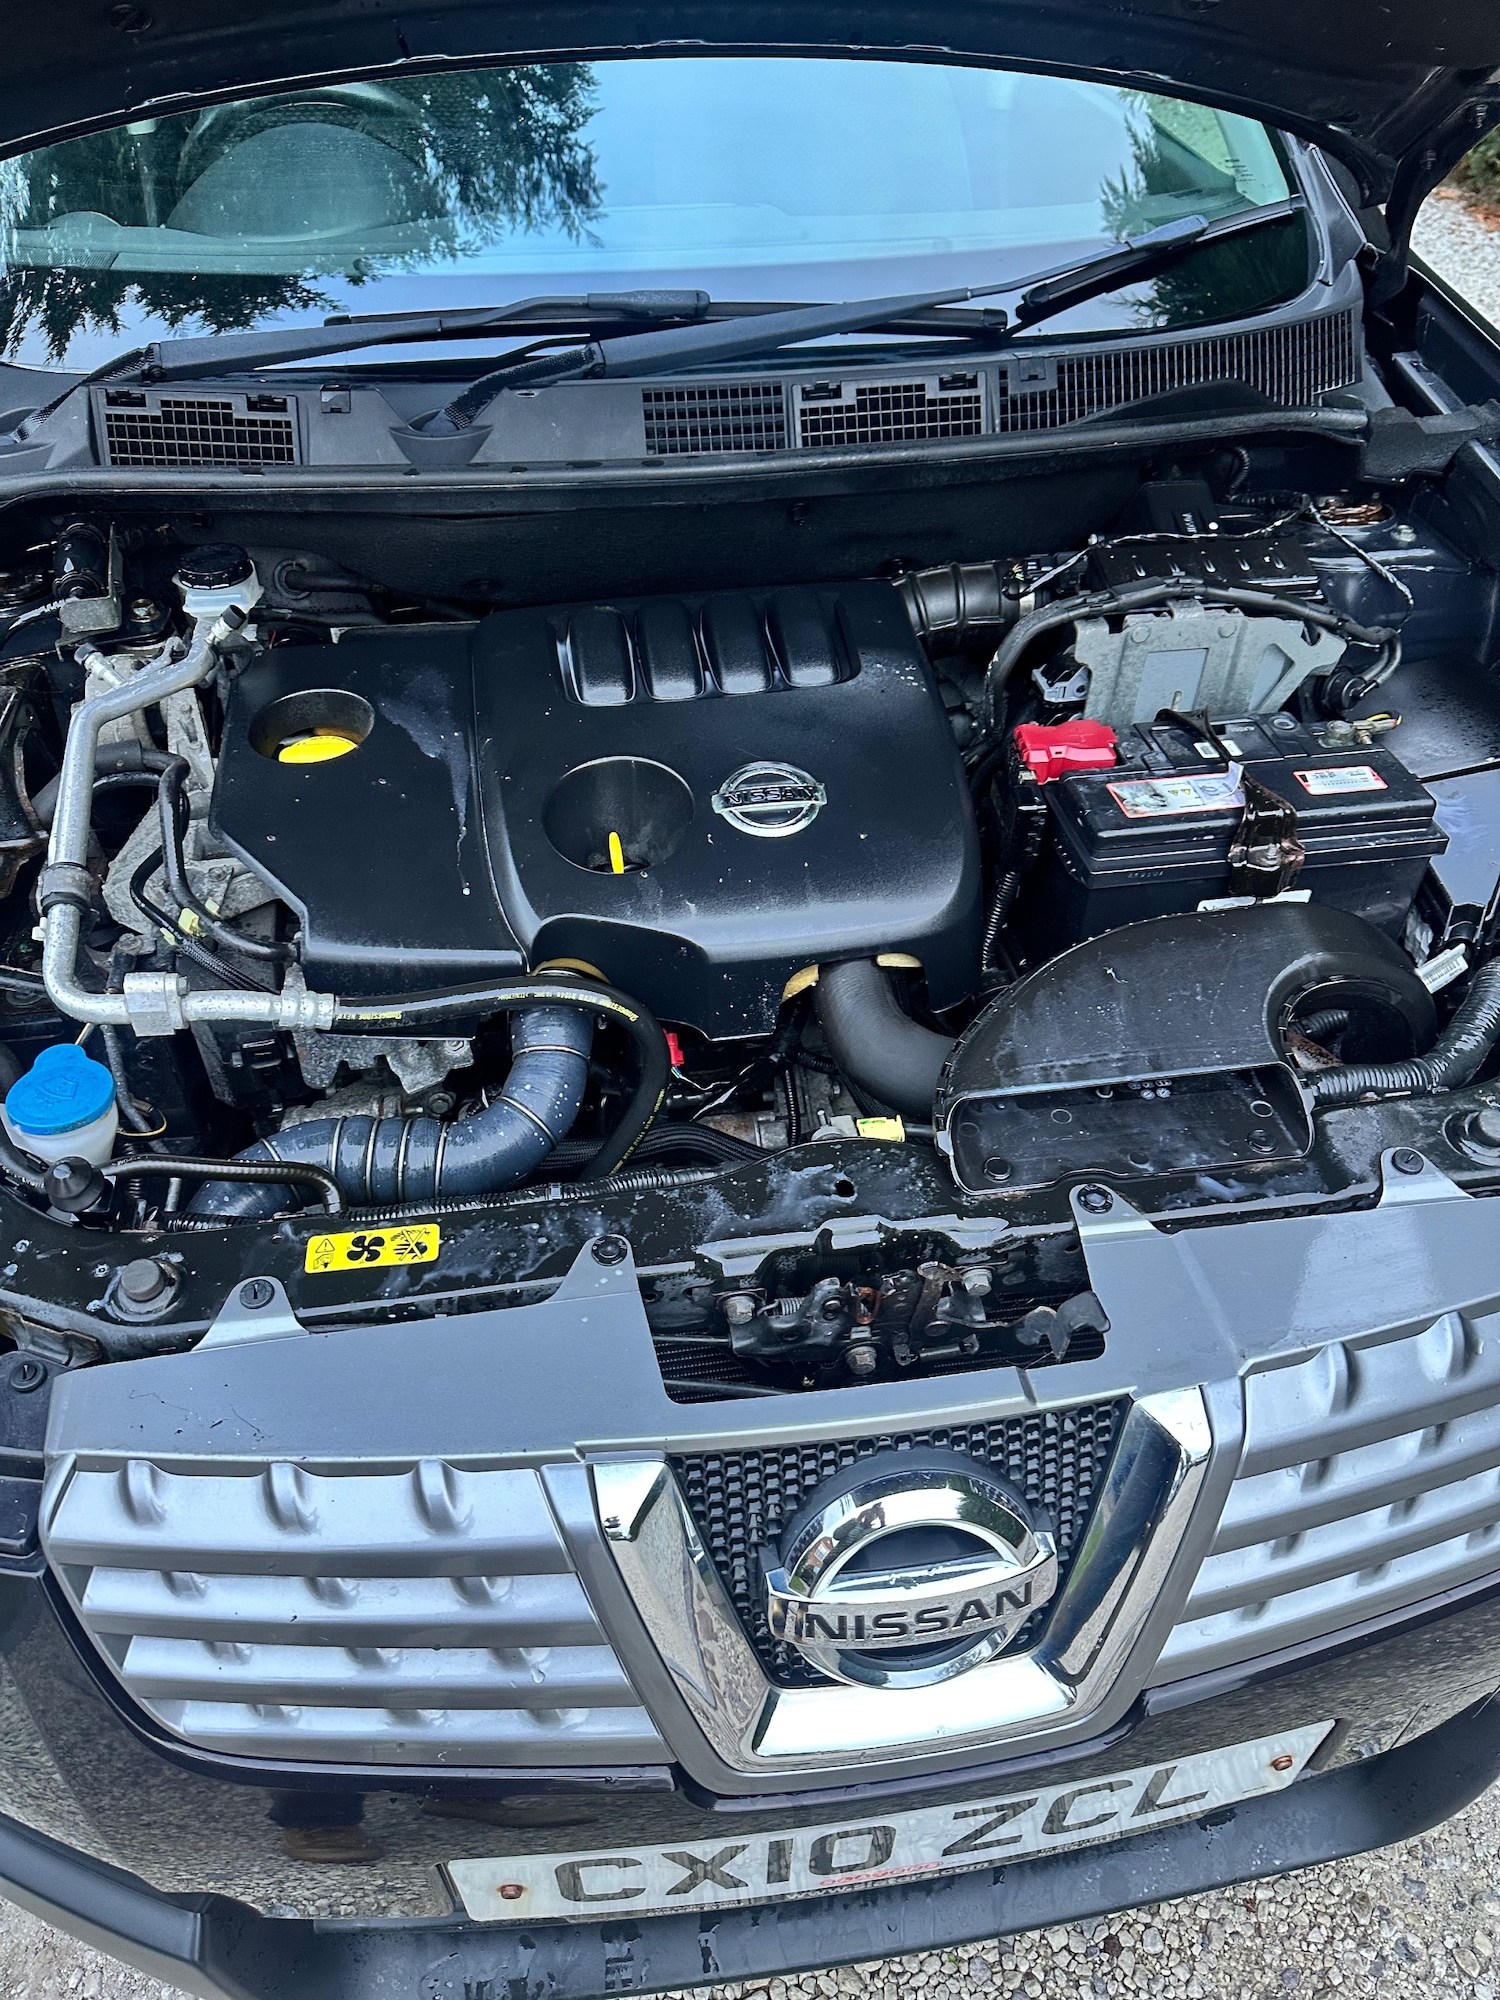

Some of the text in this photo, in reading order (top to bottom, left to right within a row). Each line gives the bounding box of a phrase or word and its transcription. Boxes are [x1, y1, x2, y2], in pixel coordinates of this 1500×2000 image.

[723, 785, 813, 805] NISSAN
[804, 1580, 1034, 1641] NISSAN
[554, 1824, 898, 1903] CX10
[941, 1765, 1210, 1858] ZCL
